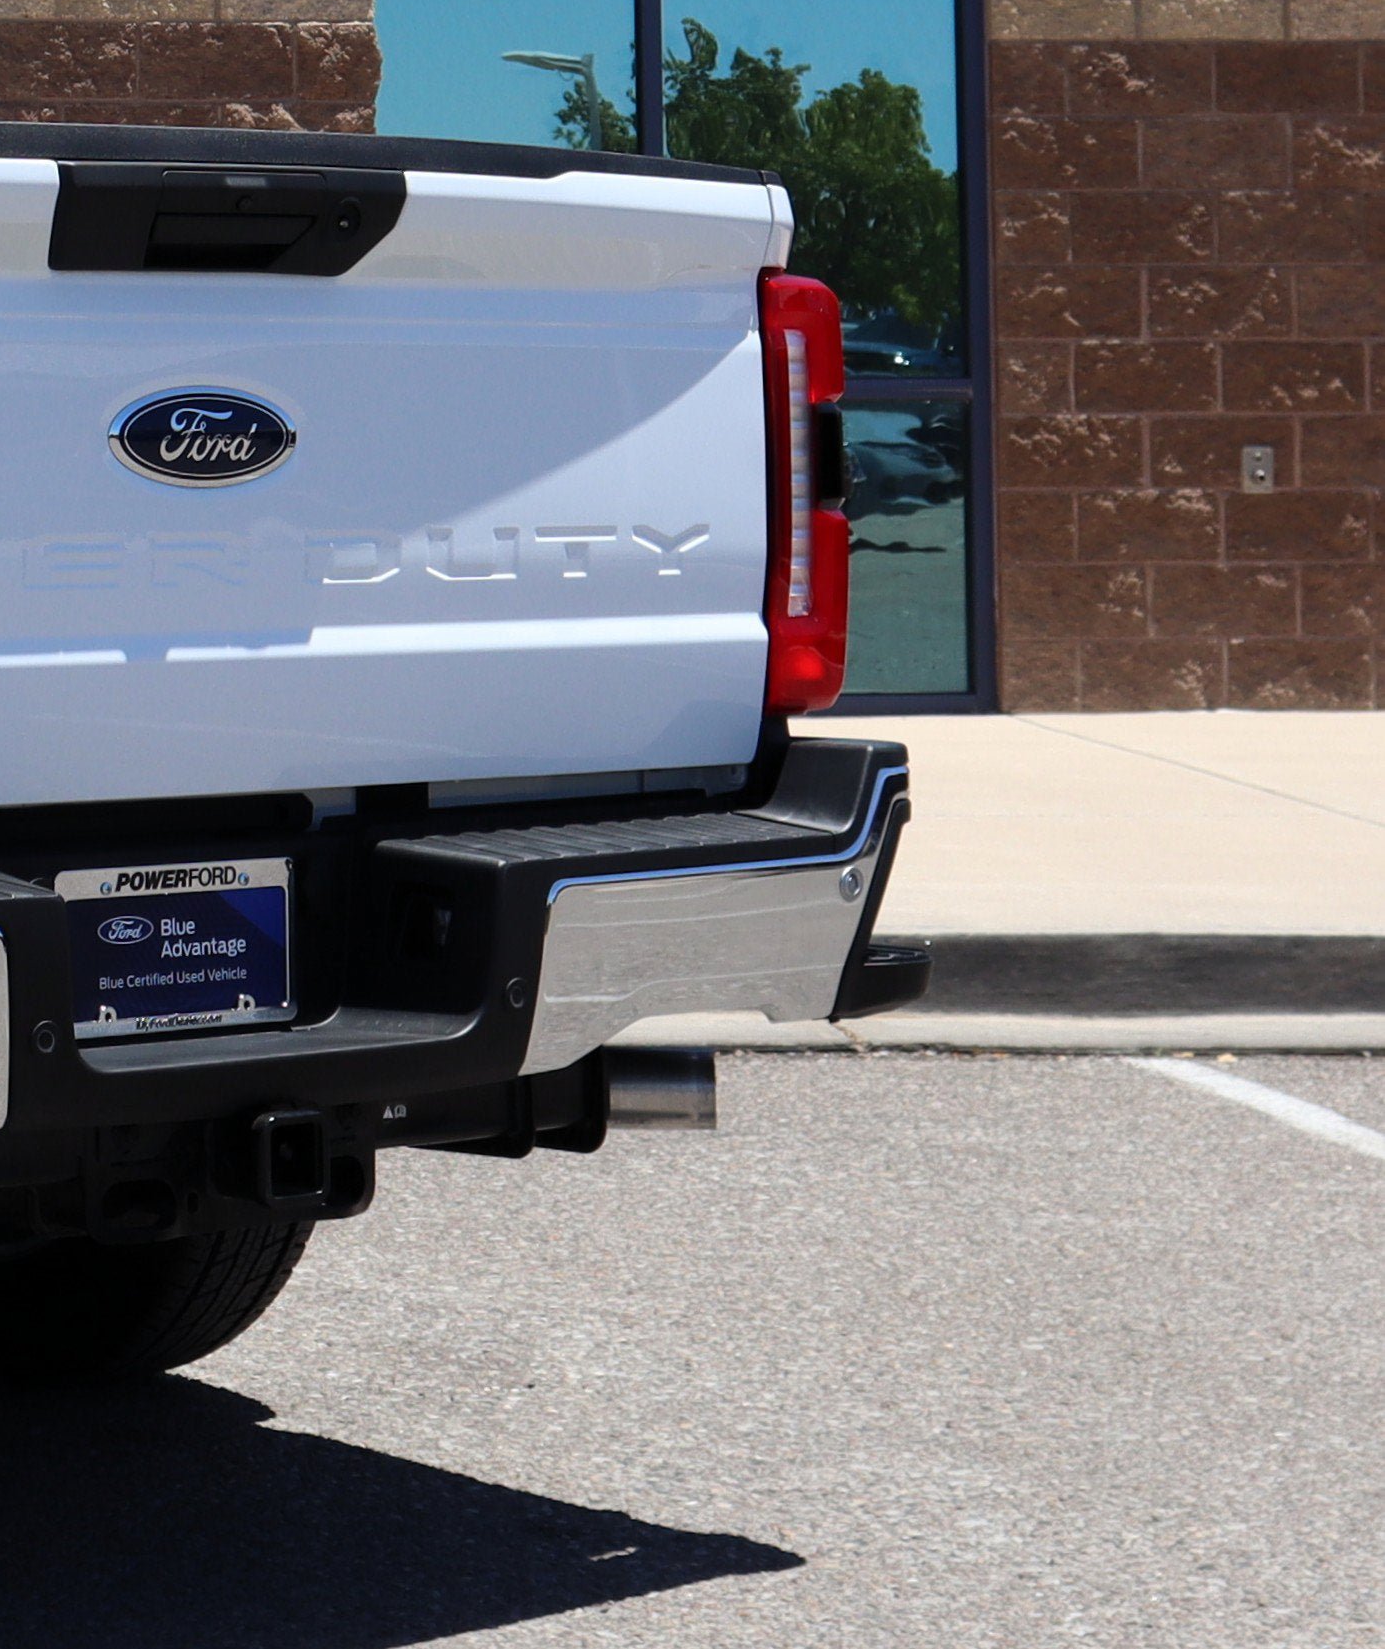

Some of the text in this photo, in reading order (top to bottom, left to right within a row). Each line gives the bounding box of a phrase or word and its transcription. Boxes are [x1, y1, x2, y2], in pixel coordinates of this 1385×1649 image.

[159, 407, 257, 462] Ford
[304, 523, 711, 585] DUTY
[114, 865, 237, 892] POWERFORD
[108, 920, 143, 940] Ford
[160, 917, 196, 936] Blue
[160, 938, 247, 958] Advantage
[99, 966, 247, 990] Blue Certified Used Vehicle
